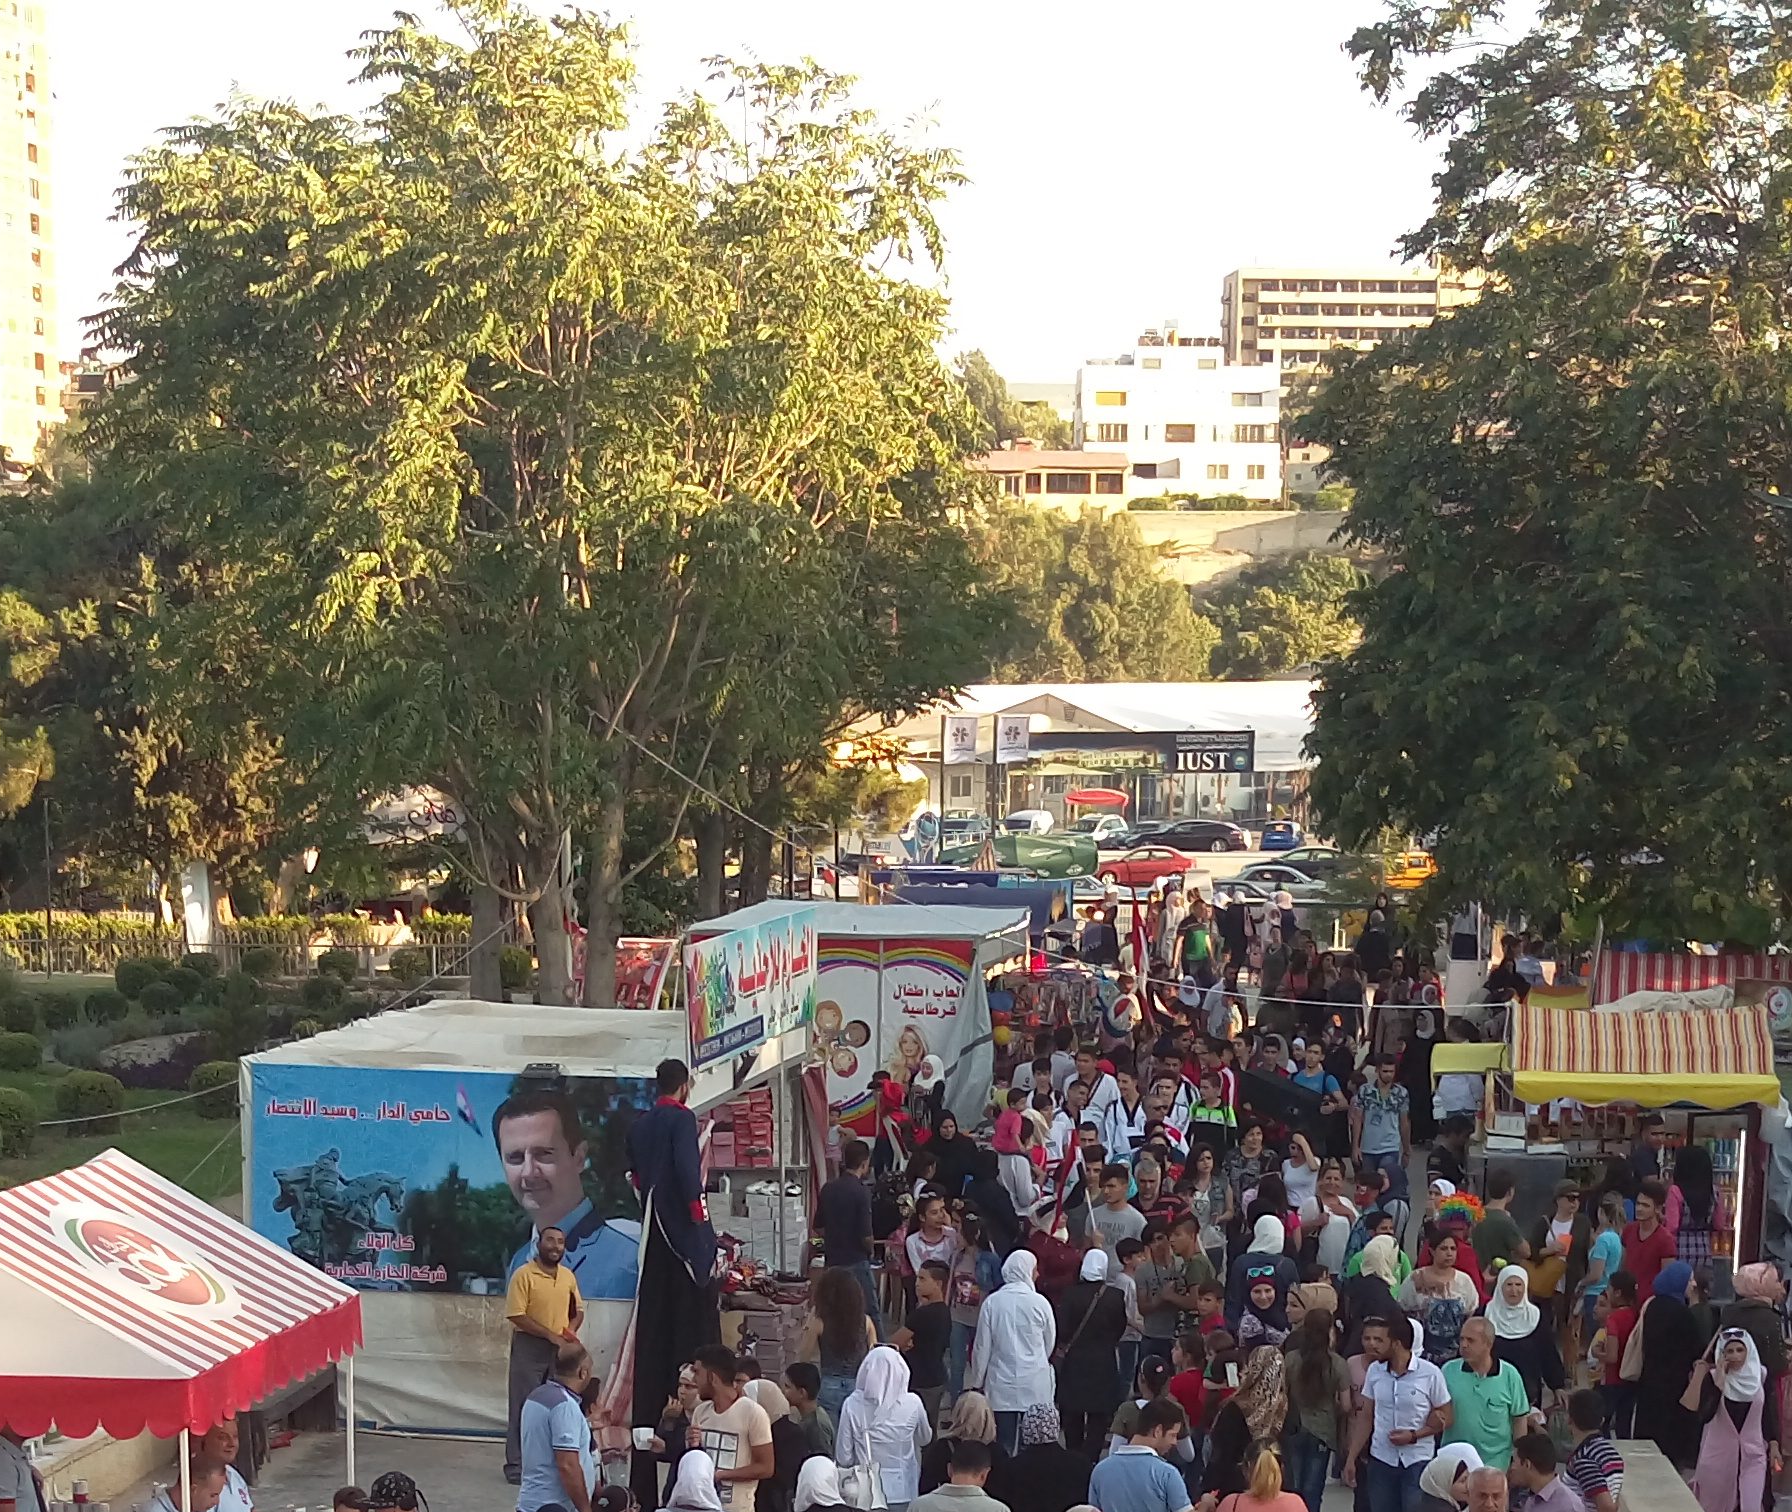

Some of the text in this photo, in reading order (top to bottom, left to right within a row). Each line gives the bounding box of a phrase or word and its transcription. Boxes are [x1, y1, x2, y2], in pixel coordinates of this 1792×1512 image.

[1176, 751, 1229, 771] IUST
[901, 1000, 957, 1018] قرطاسية
[320, 1104, 358, 1121] وسيد
[376, 1101, 406, 1121] الدار
[408, 1103, 451, 1125] حامي
[358, 1232, 415, 1251] كل الولاء
[324, 1261, 373, 1279] التجارية
[410, 1264, 448, 1284] شركة
